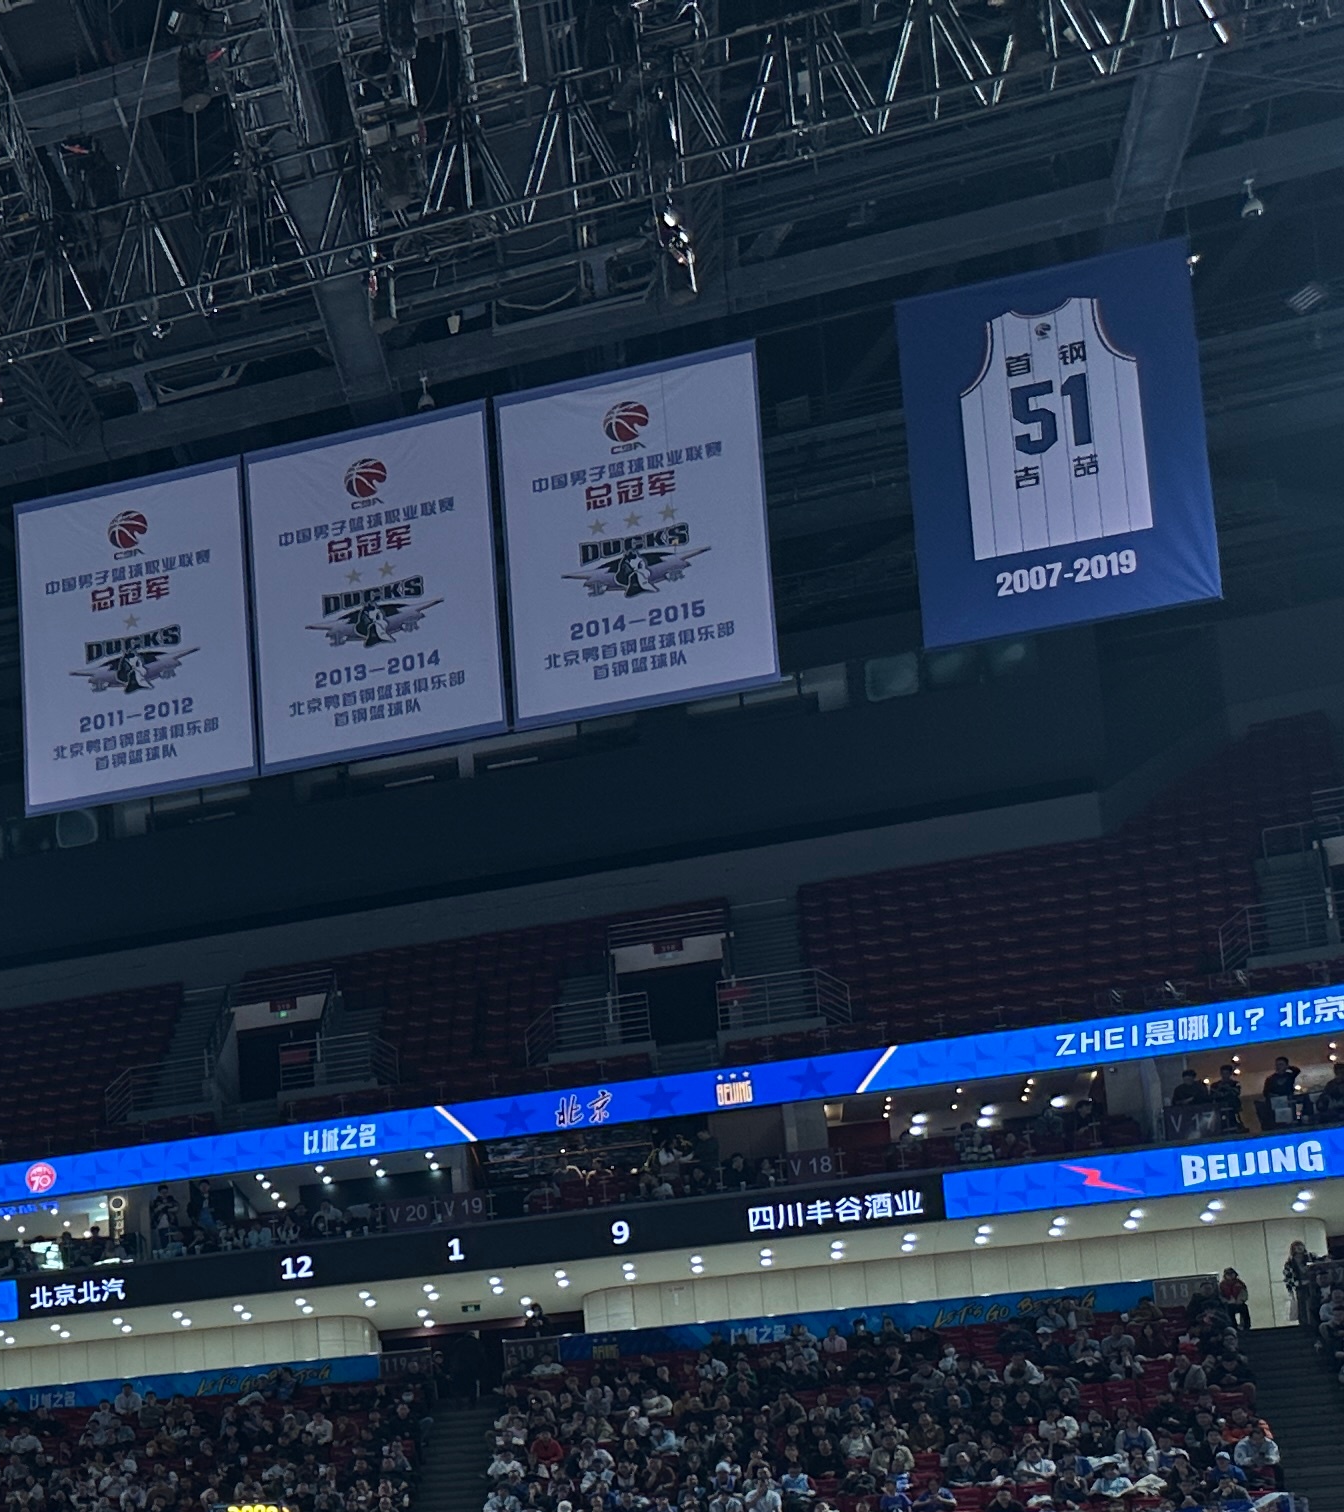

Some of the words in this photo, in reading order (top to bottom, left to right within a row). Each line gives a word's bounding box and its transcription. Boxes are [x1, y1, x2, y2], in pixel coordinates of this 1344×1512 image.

[1011, 373, 1092, 456] 51
[585, 470, 676, 512] 总冠军
[327, 524, 411, 564] 总冠军
[579, 522, 689, 566] DUCKS
[91, 576, 169, 612] 总冠军
[997, 549, 1137, 597] 2007-2019
[322, 574, 424, 618] DUCKS
[85, 624, 181, 664] DUCKS
[556, 1090, 612, 1128] 北京
[304, 1124, 376, 1155] 以城之名
[1181, 1140, 1324, 1187] BEIJING
[30, 1278, 126, 1310] 北京北汽
[281, 1256, 313, 1280] 12
[448, 1238, 464, 1262] 1
[611, 1221, 630, 1245] 9
[748, 1190, 924, 1232] 四川丰谷酒业
